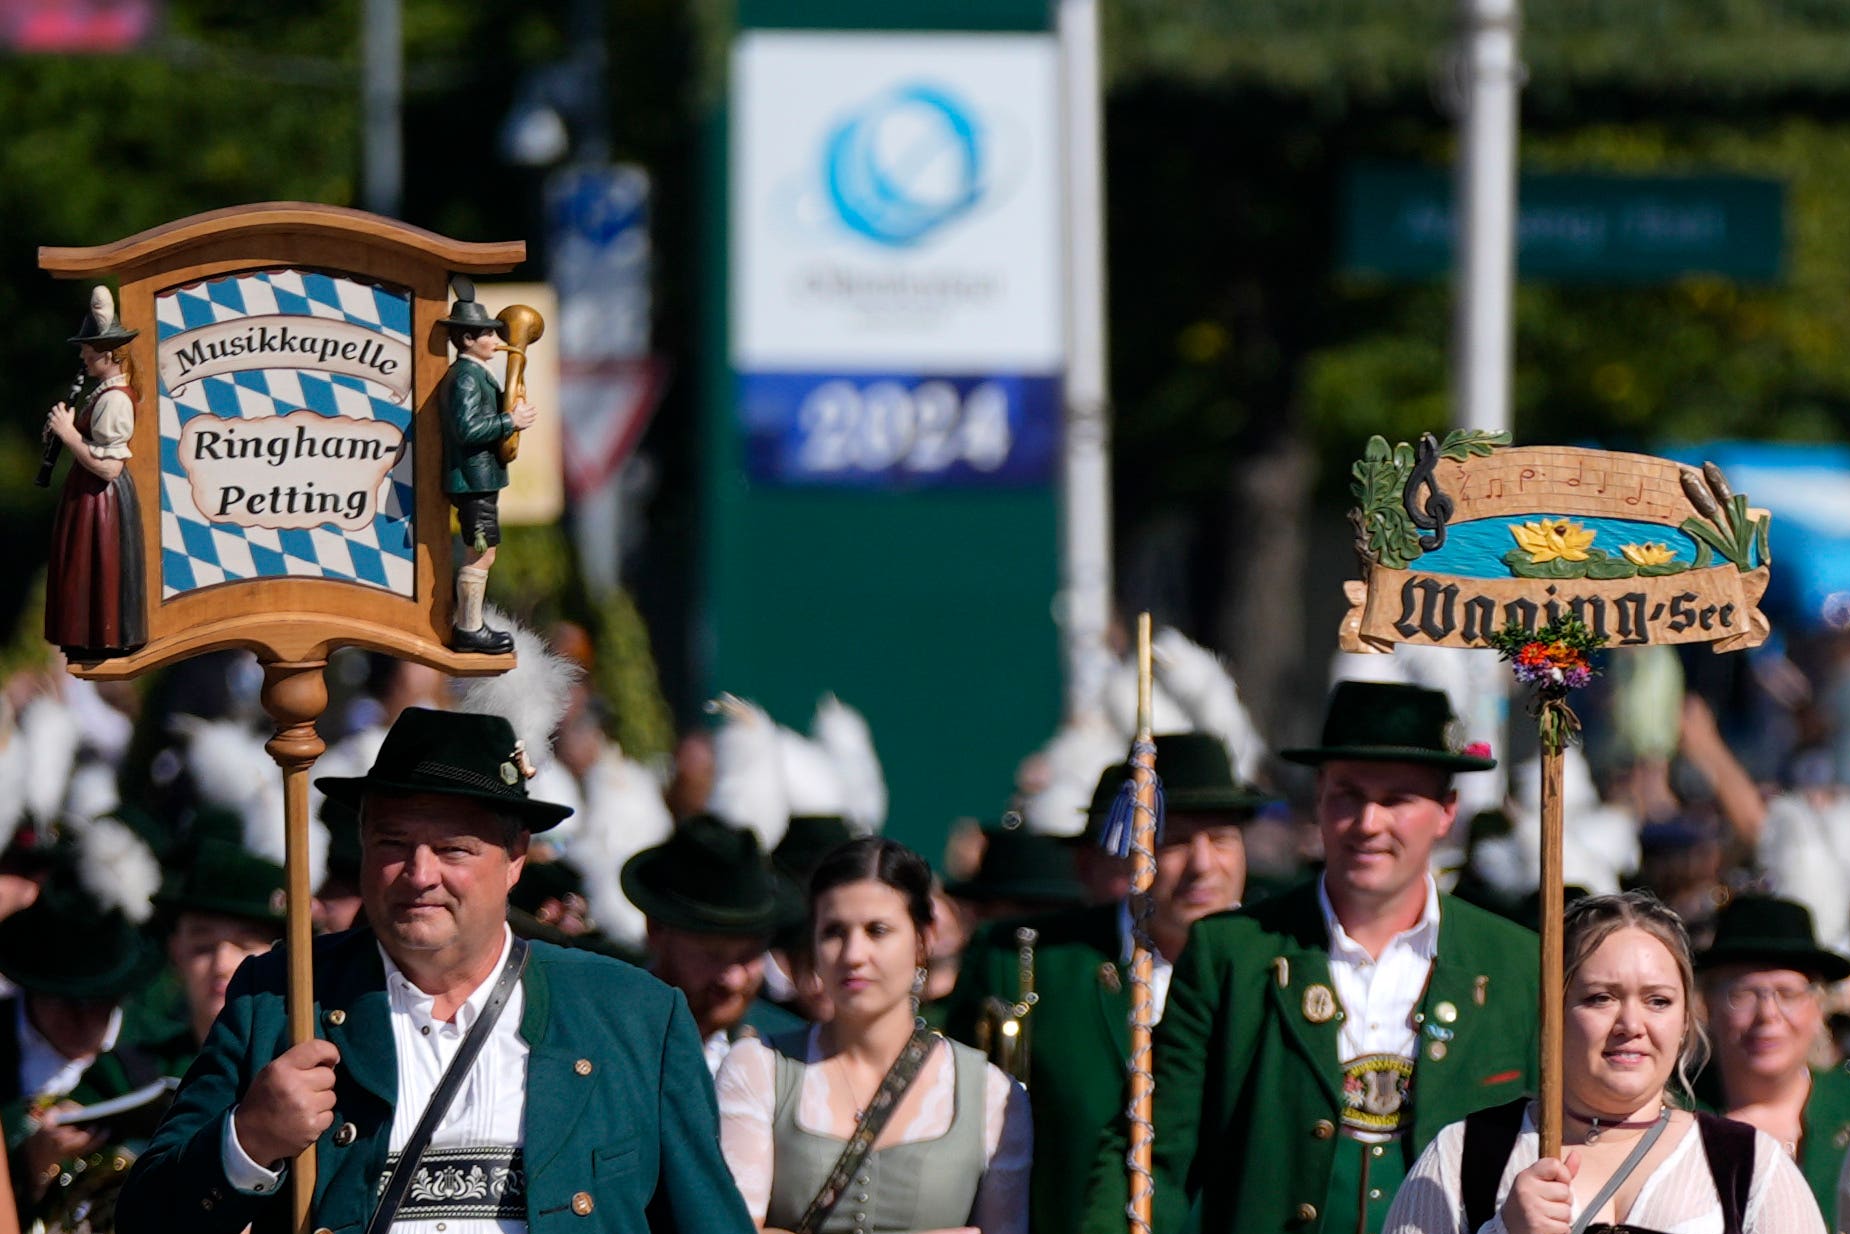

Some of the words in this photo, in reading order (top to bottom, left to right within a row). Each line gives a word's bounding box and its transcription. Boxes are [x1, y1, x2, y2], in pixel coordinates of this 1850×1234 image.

[174, 326, 399, 377] Musikkapelle
[193, 426, 400, 467] Ringham-
[802, 380, 1012, 472] 2024
[215, 481, 369, 520] Petting
